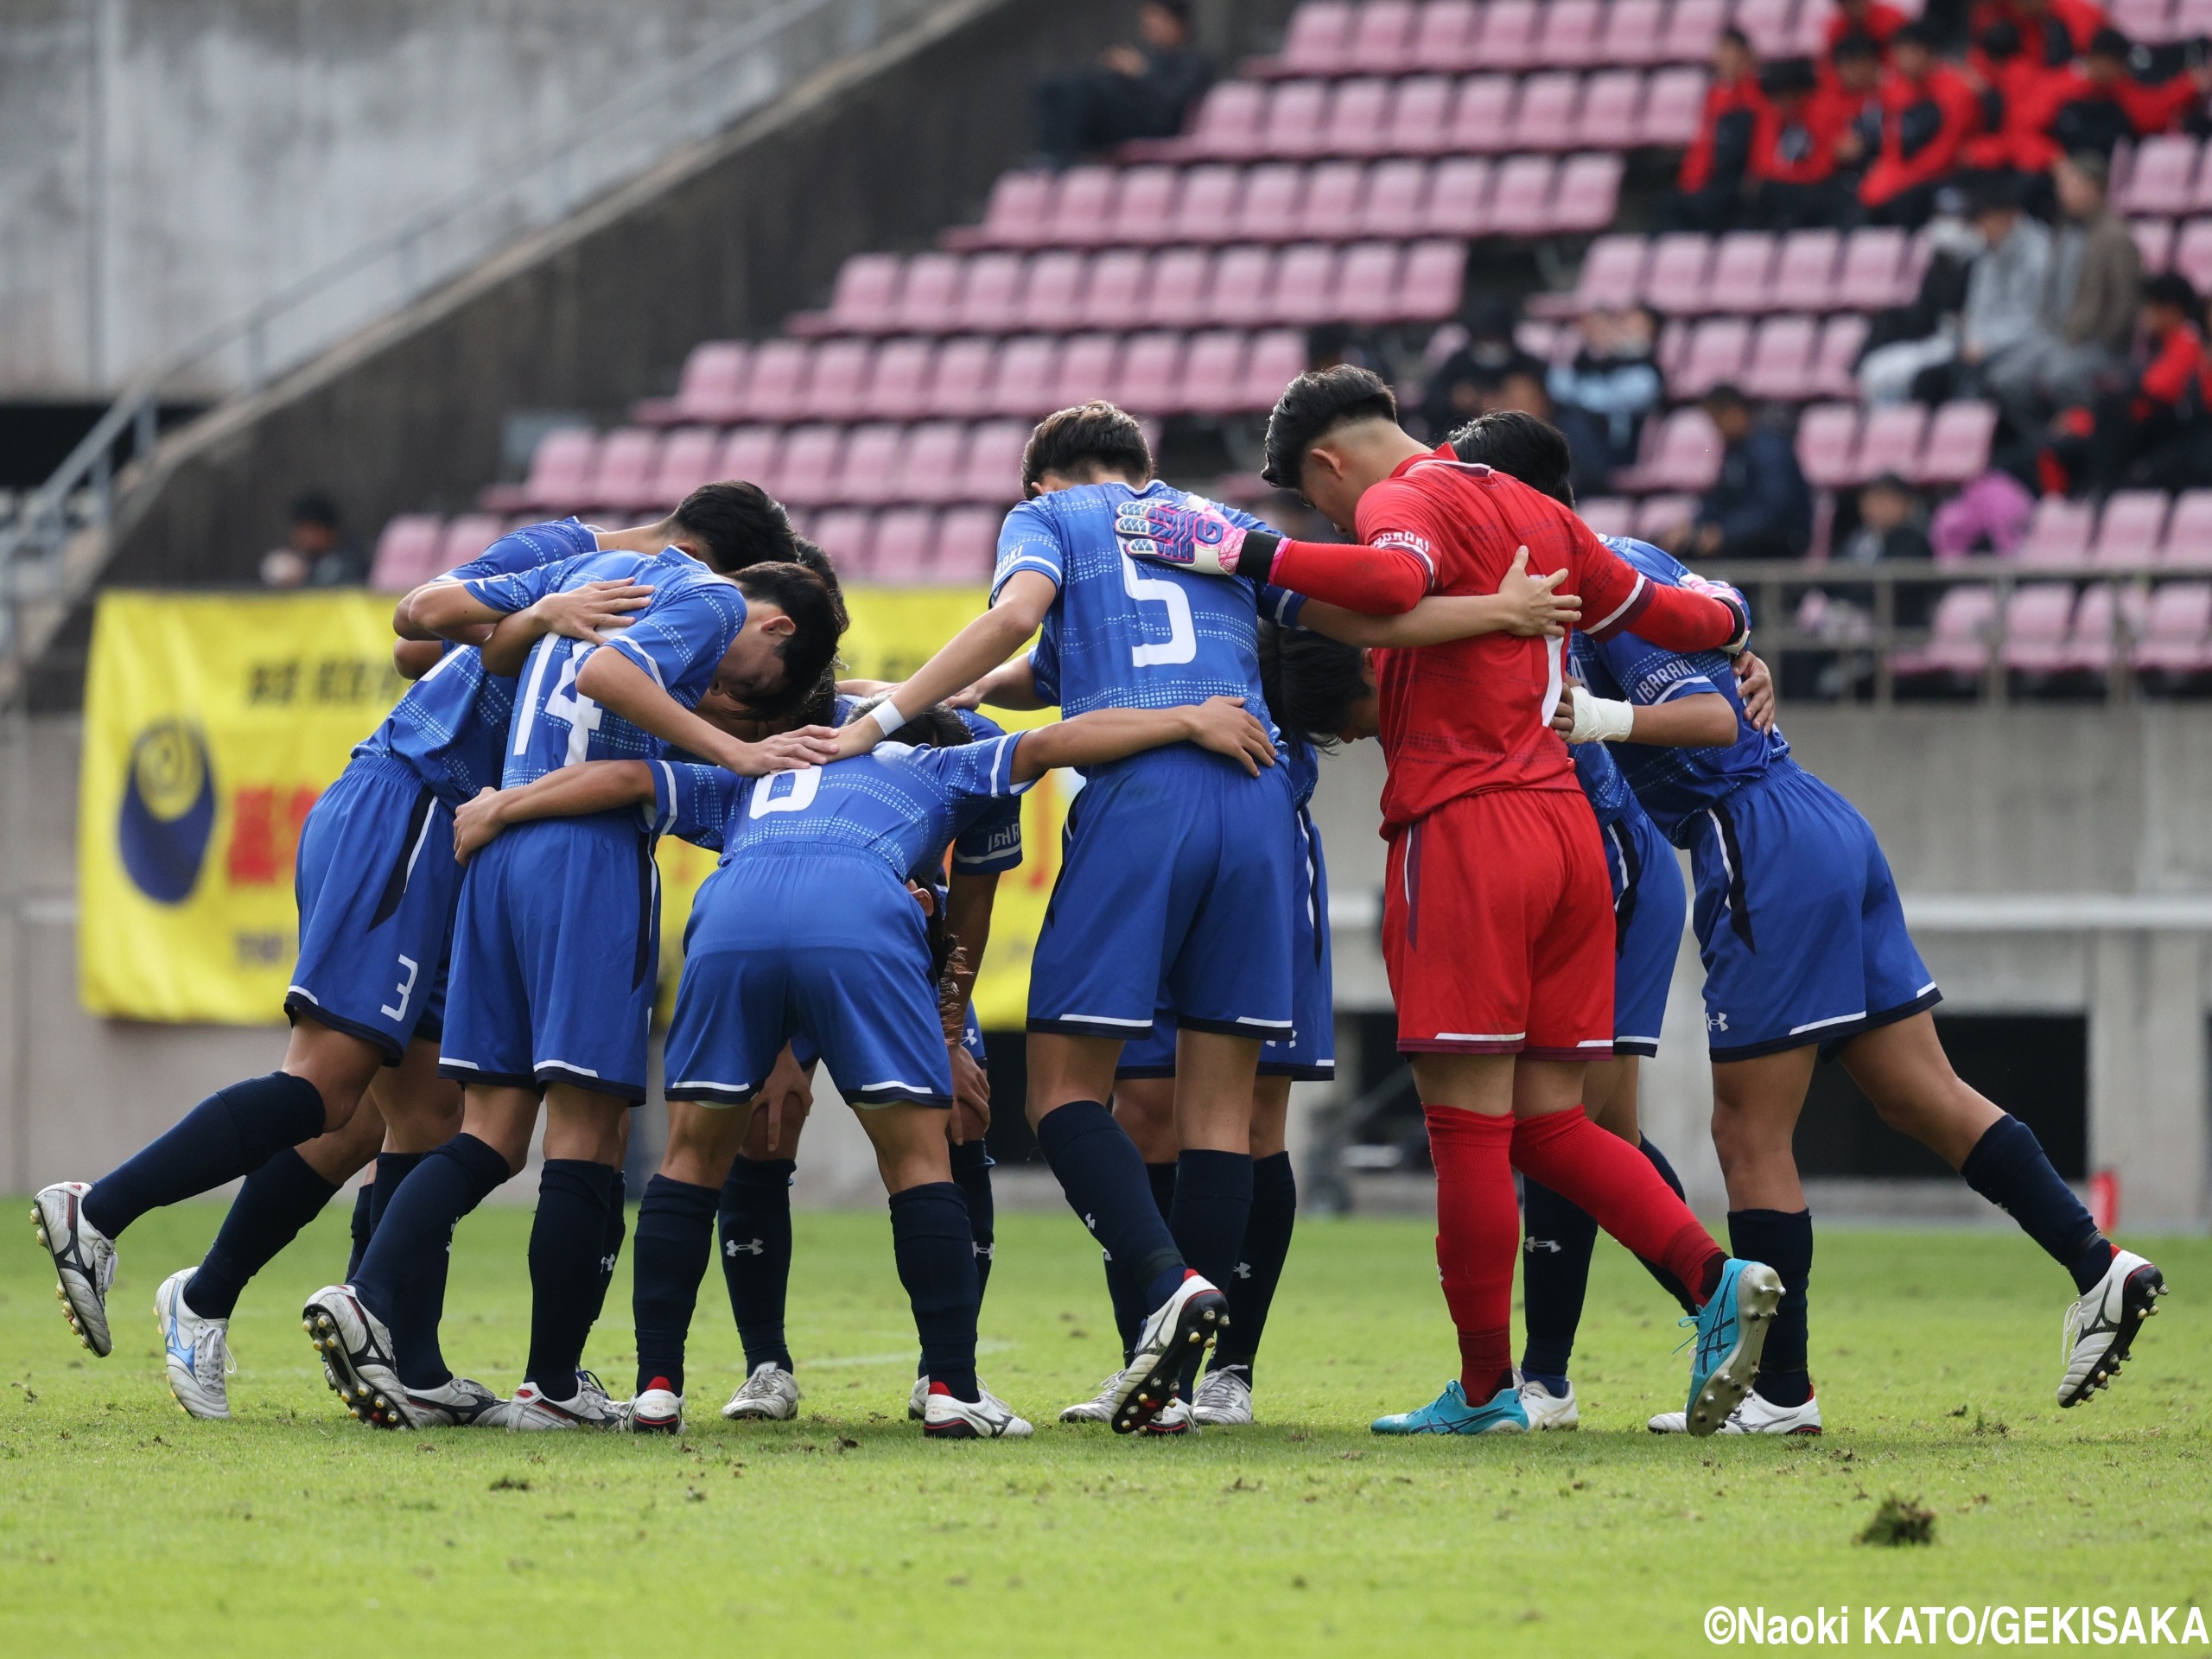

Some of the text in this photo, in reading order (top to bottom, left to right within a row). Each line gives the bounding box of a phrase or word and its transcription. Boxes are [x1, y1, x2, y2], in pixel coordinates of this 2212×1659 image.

[1116, 534, 1197, 668] 5
[513, 626, 624, 766] 14
[1636, 659, 1697, 704] IBARAKI
[380, 953, 418, 1022] 3
